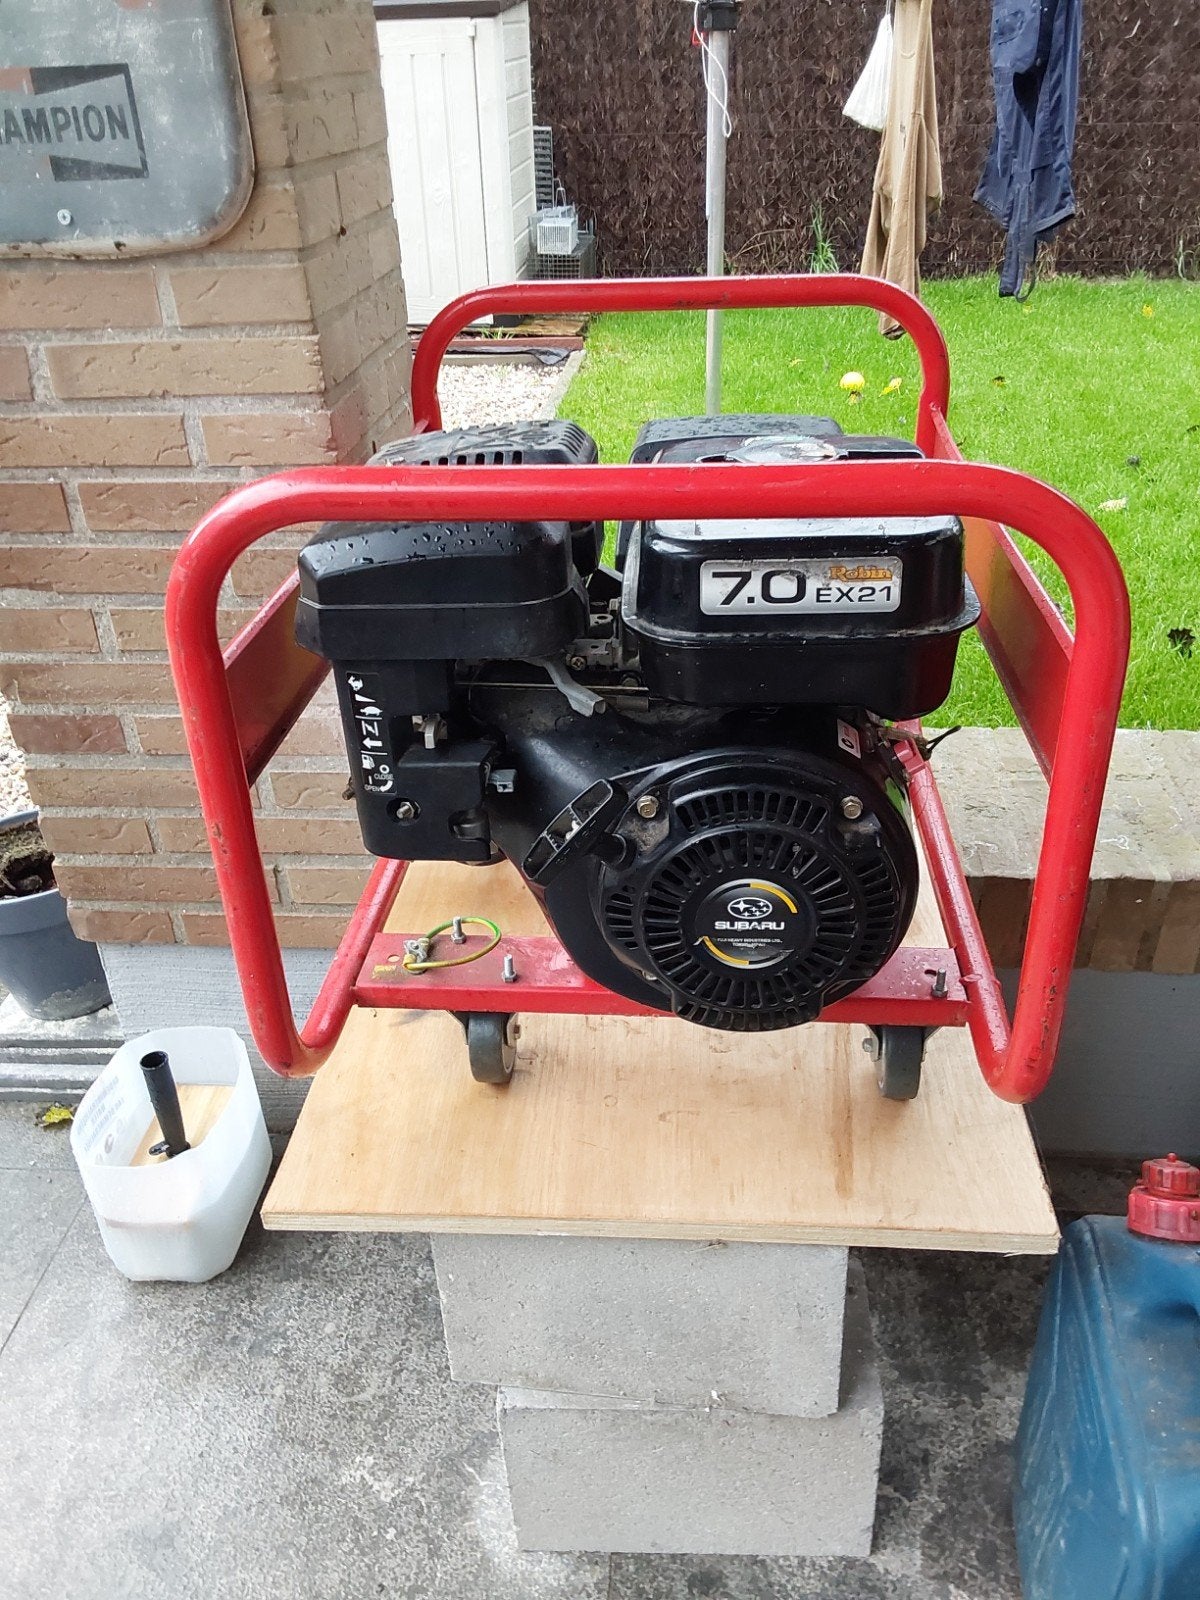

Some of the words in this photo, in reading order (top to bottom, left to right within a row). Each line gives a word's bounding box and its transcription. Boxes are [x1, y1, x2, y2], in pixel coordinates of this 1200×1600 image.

[0, 104, 130, 144] AMPION
[829, 565, 893, 582] Robin
[712, 569, 807, 606] 7.0
[816, 586, 892, 603] EX21
[714, 921, 785, 931] SUBARU
